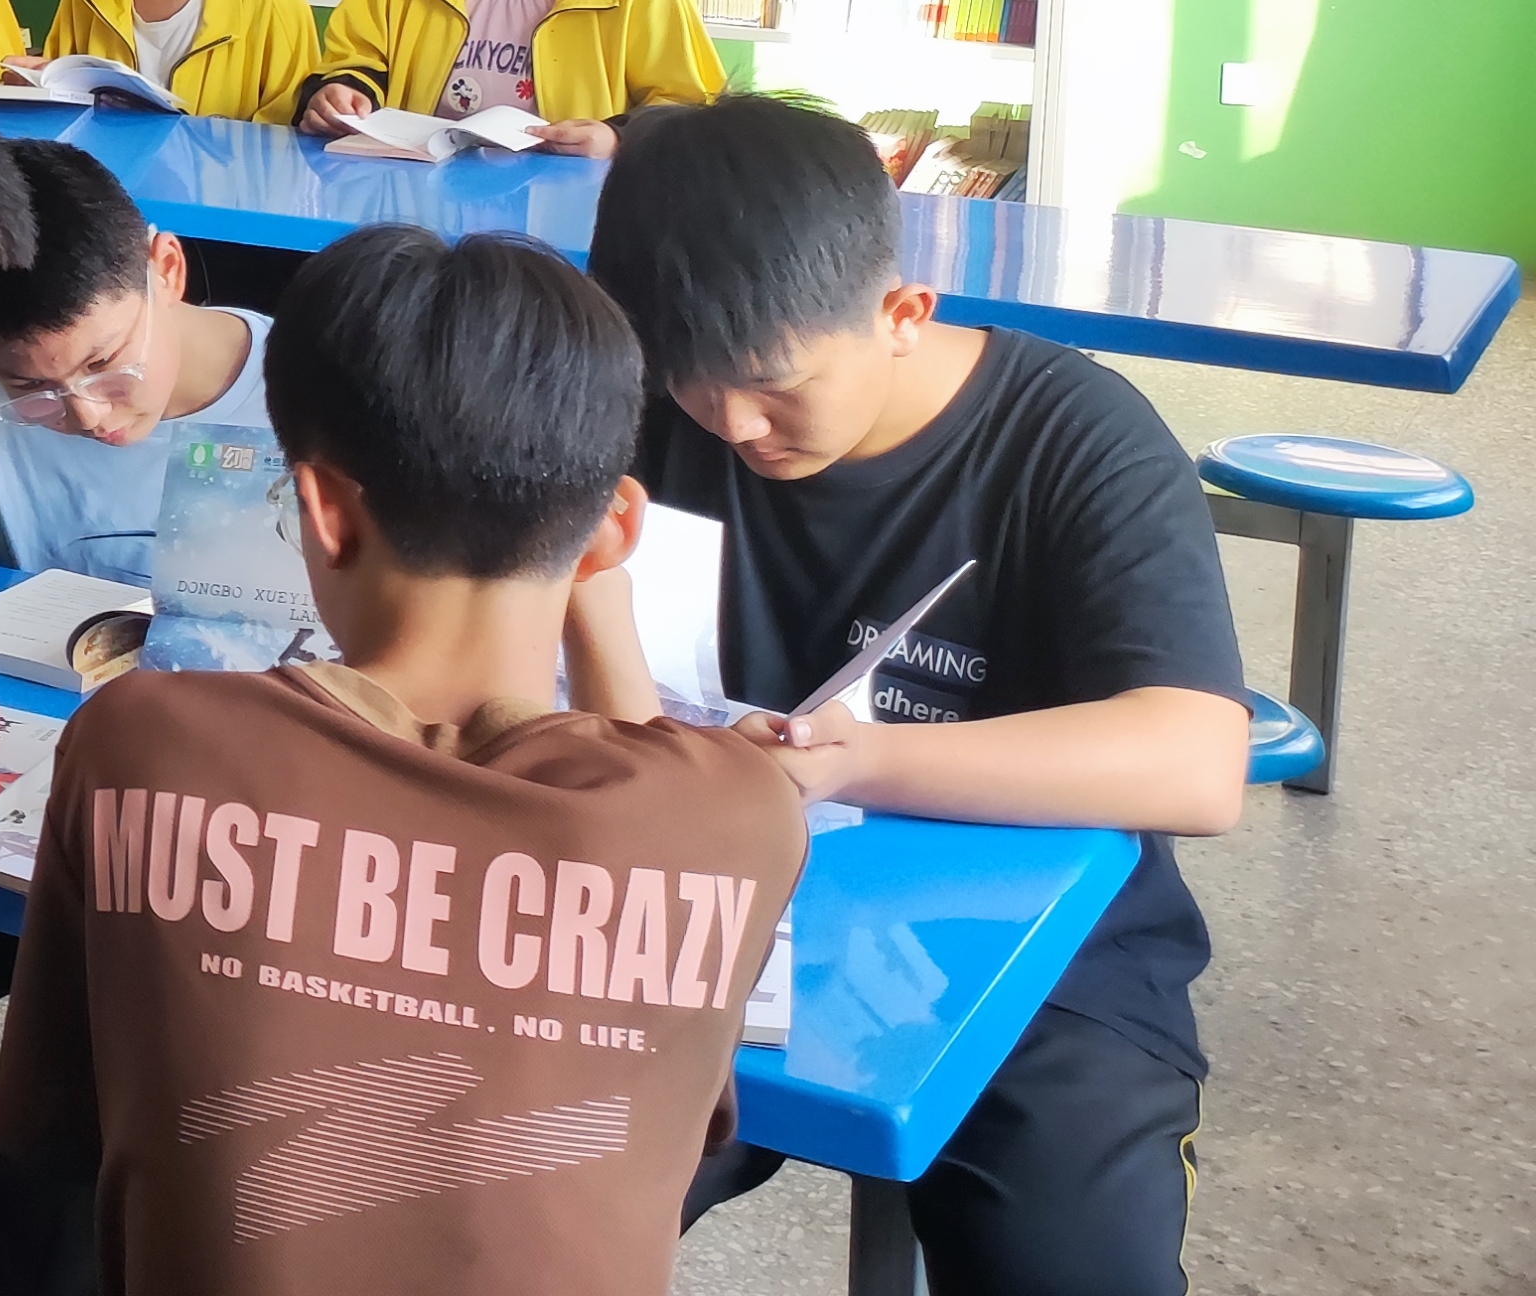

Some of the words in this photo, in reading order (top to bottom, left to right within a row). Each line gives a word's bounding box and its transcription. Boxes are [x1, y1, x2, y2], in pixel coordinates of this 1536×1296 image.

[176, 580, 244, 600] DONGBO
[92, 788, 322, 944] MUST
[332, 830, 451, 977] BE
[477, 851, 758, 1010] CRAZY
[200, 952, 243, 980] NO
[513, 1014, 563, 1042] NO
[579, 1023, 658, 1053] LIFE.
